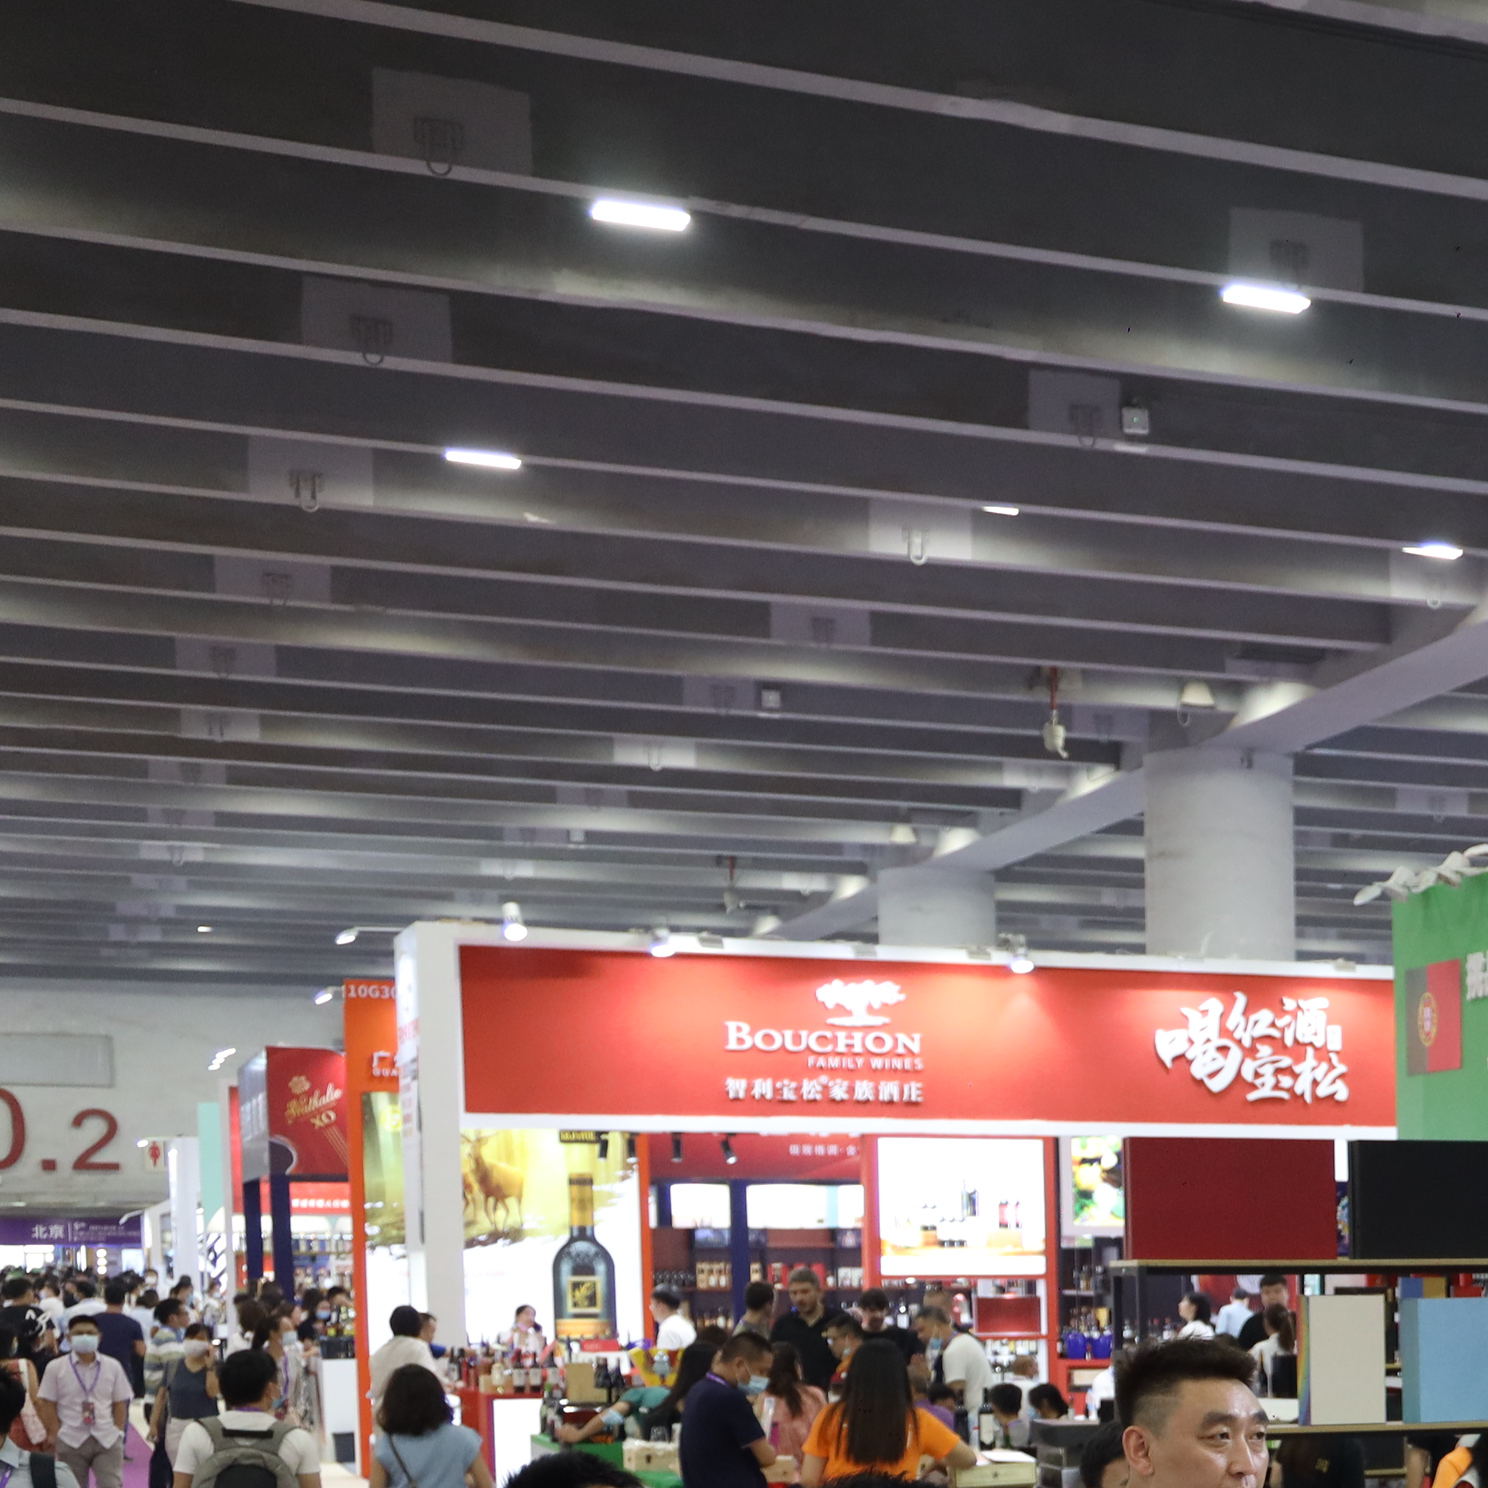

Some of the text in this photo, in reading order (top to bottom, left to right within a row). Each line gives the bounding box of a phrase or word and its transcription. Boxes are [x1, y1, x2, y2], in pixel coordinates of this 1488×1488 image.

[724, 1020, 923, 1054] BOUCHON
[808, 1055, 924, 1070] FAMILY WINES
[311, 1110, 337, 1129] XO
[32, 1223, 65, 1240] 北京
